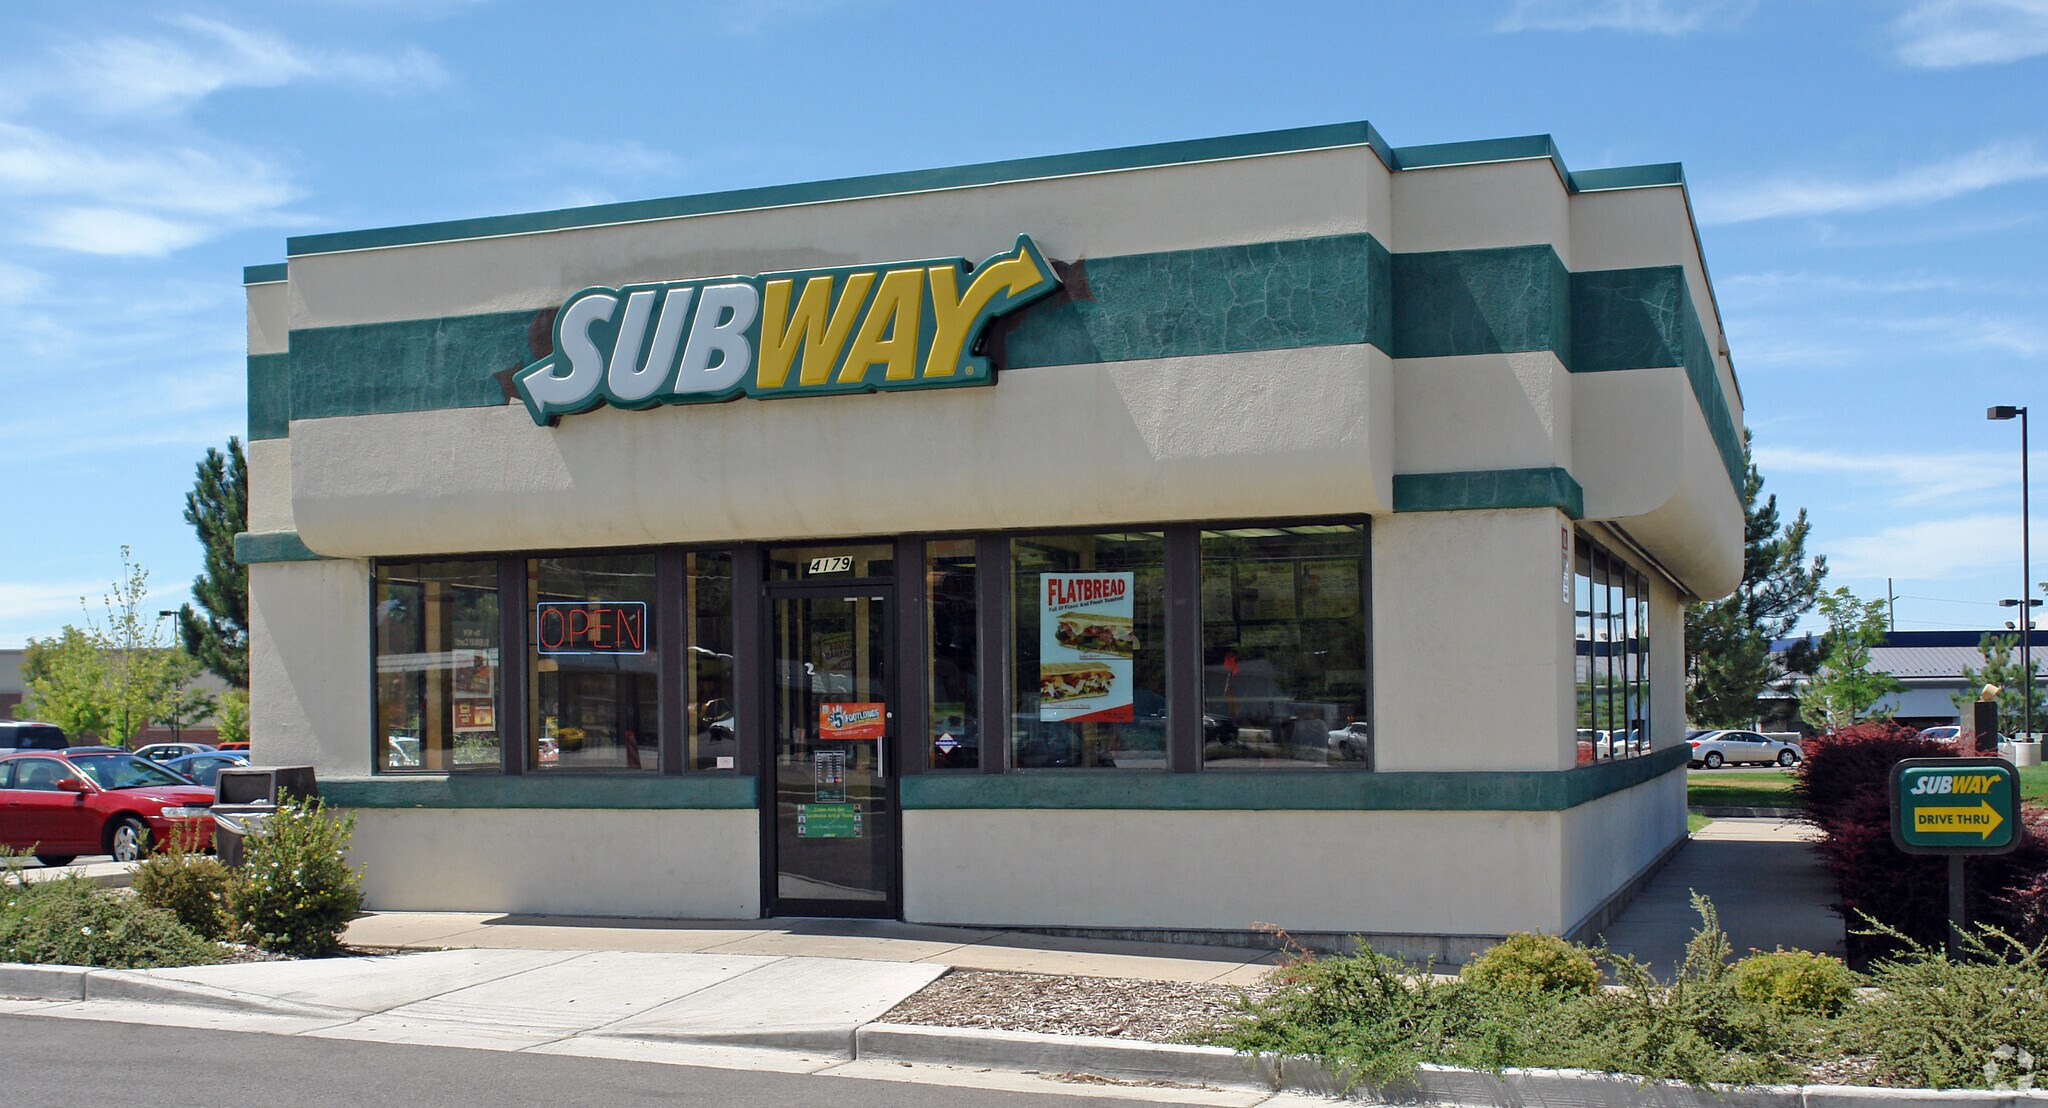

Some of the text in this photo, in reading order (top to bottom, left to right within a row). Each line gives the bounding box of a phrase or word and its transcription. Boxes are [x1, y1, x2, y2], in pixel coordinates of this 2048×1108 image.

[522, 246, 1044, 412] SUBWAY
[811, 557, 850, 572] 4179
[1048, 578, 1126, 606] FLATBREAD
[540, 608, 641, 649] OPEN
[828, 709, 880, 729] $5 FOOTLONGS
[1910, 774, 2002, 795] SUBWAY
[1918, 814, 1990, 825] DRIVE THRU
